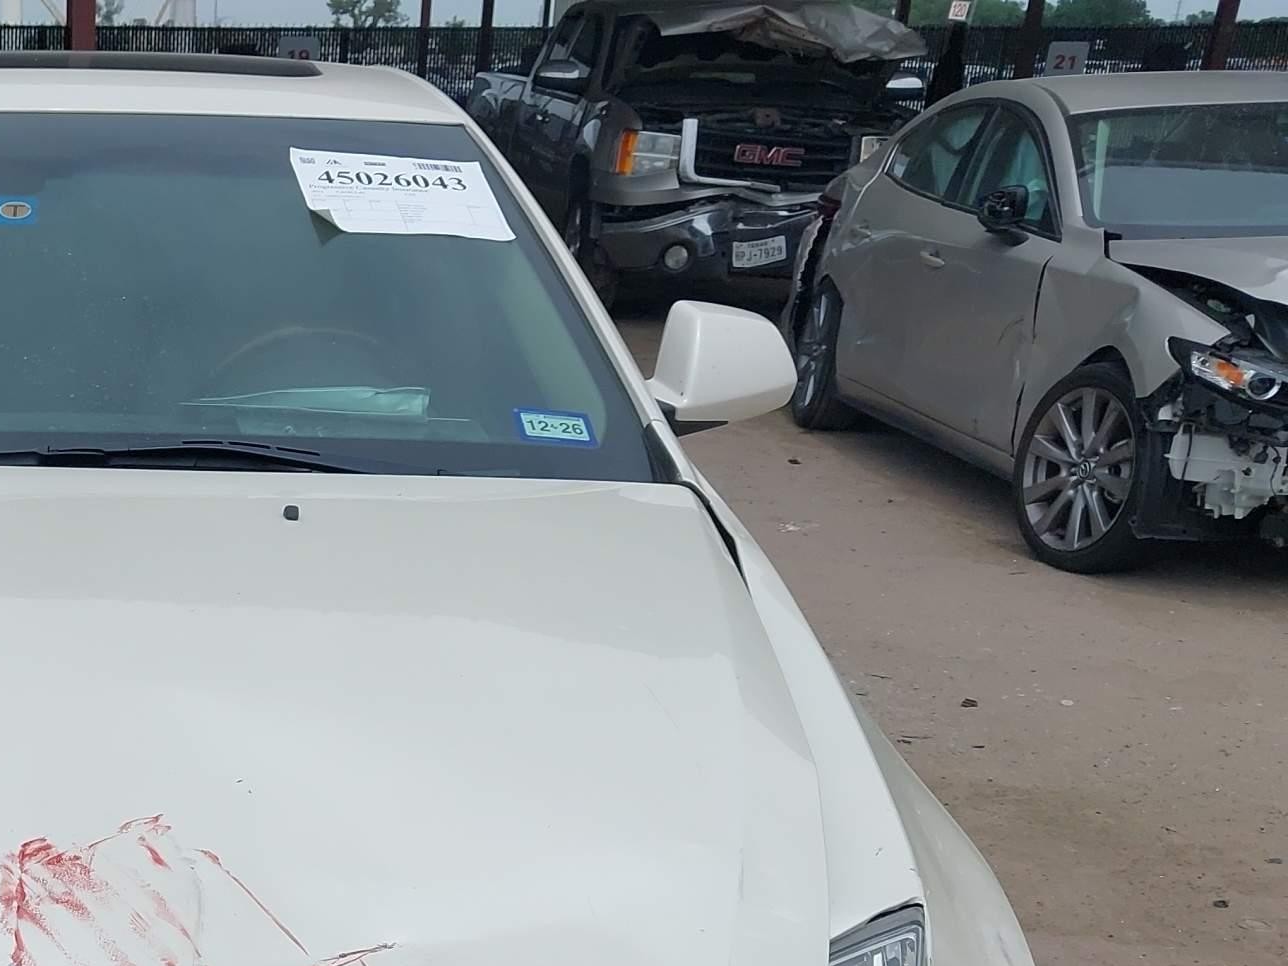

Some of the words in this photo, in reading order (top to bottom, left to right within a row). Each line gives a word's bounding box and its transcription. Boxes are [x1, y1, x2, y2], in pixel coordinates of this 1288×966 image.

[1053, 55, 1078, 69] 21
[734, 145, 804, 167] GMC
[318, 170, 467, 190] 45026043
